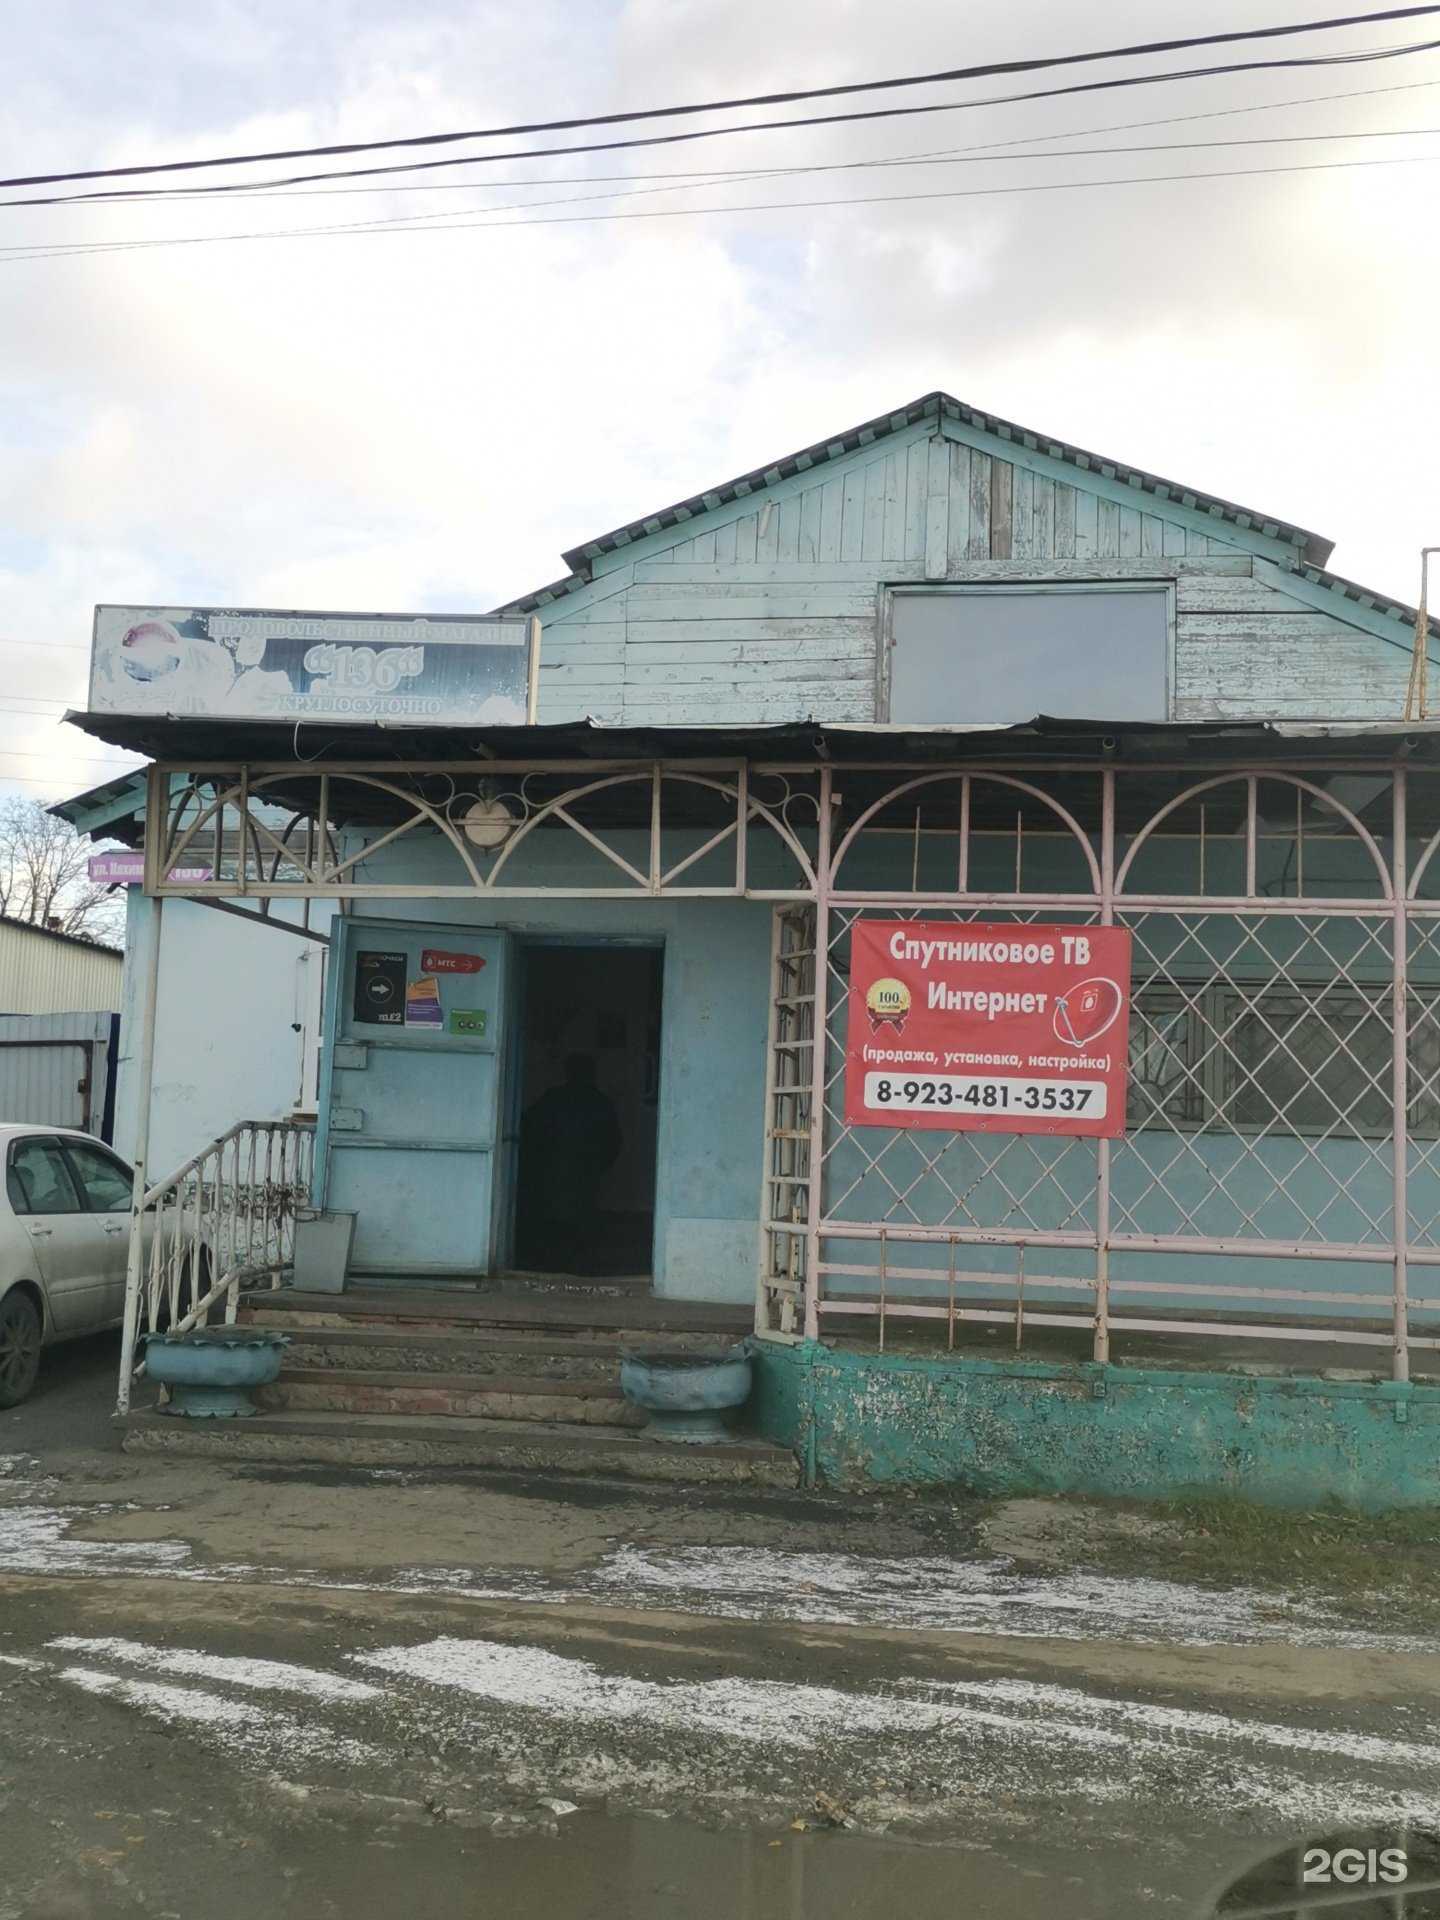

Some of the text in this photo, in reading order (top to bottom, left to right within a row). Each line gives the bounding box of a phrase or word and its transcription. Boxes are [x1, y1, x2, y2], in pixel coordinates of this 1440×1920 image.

[278, 696, 441, 714] КРУГЛОСУТОЧНО
[437, 959, 456, 968] МТС
[890, 931, 1091, 968] Спутниковое ТВ
[928, 982, 1048, 1020] Интернет
[863, 1044, 1111, 1073] (продажа, установка, настройка)
[877, 1080, 1093, 1111] 8-923-481-3537
